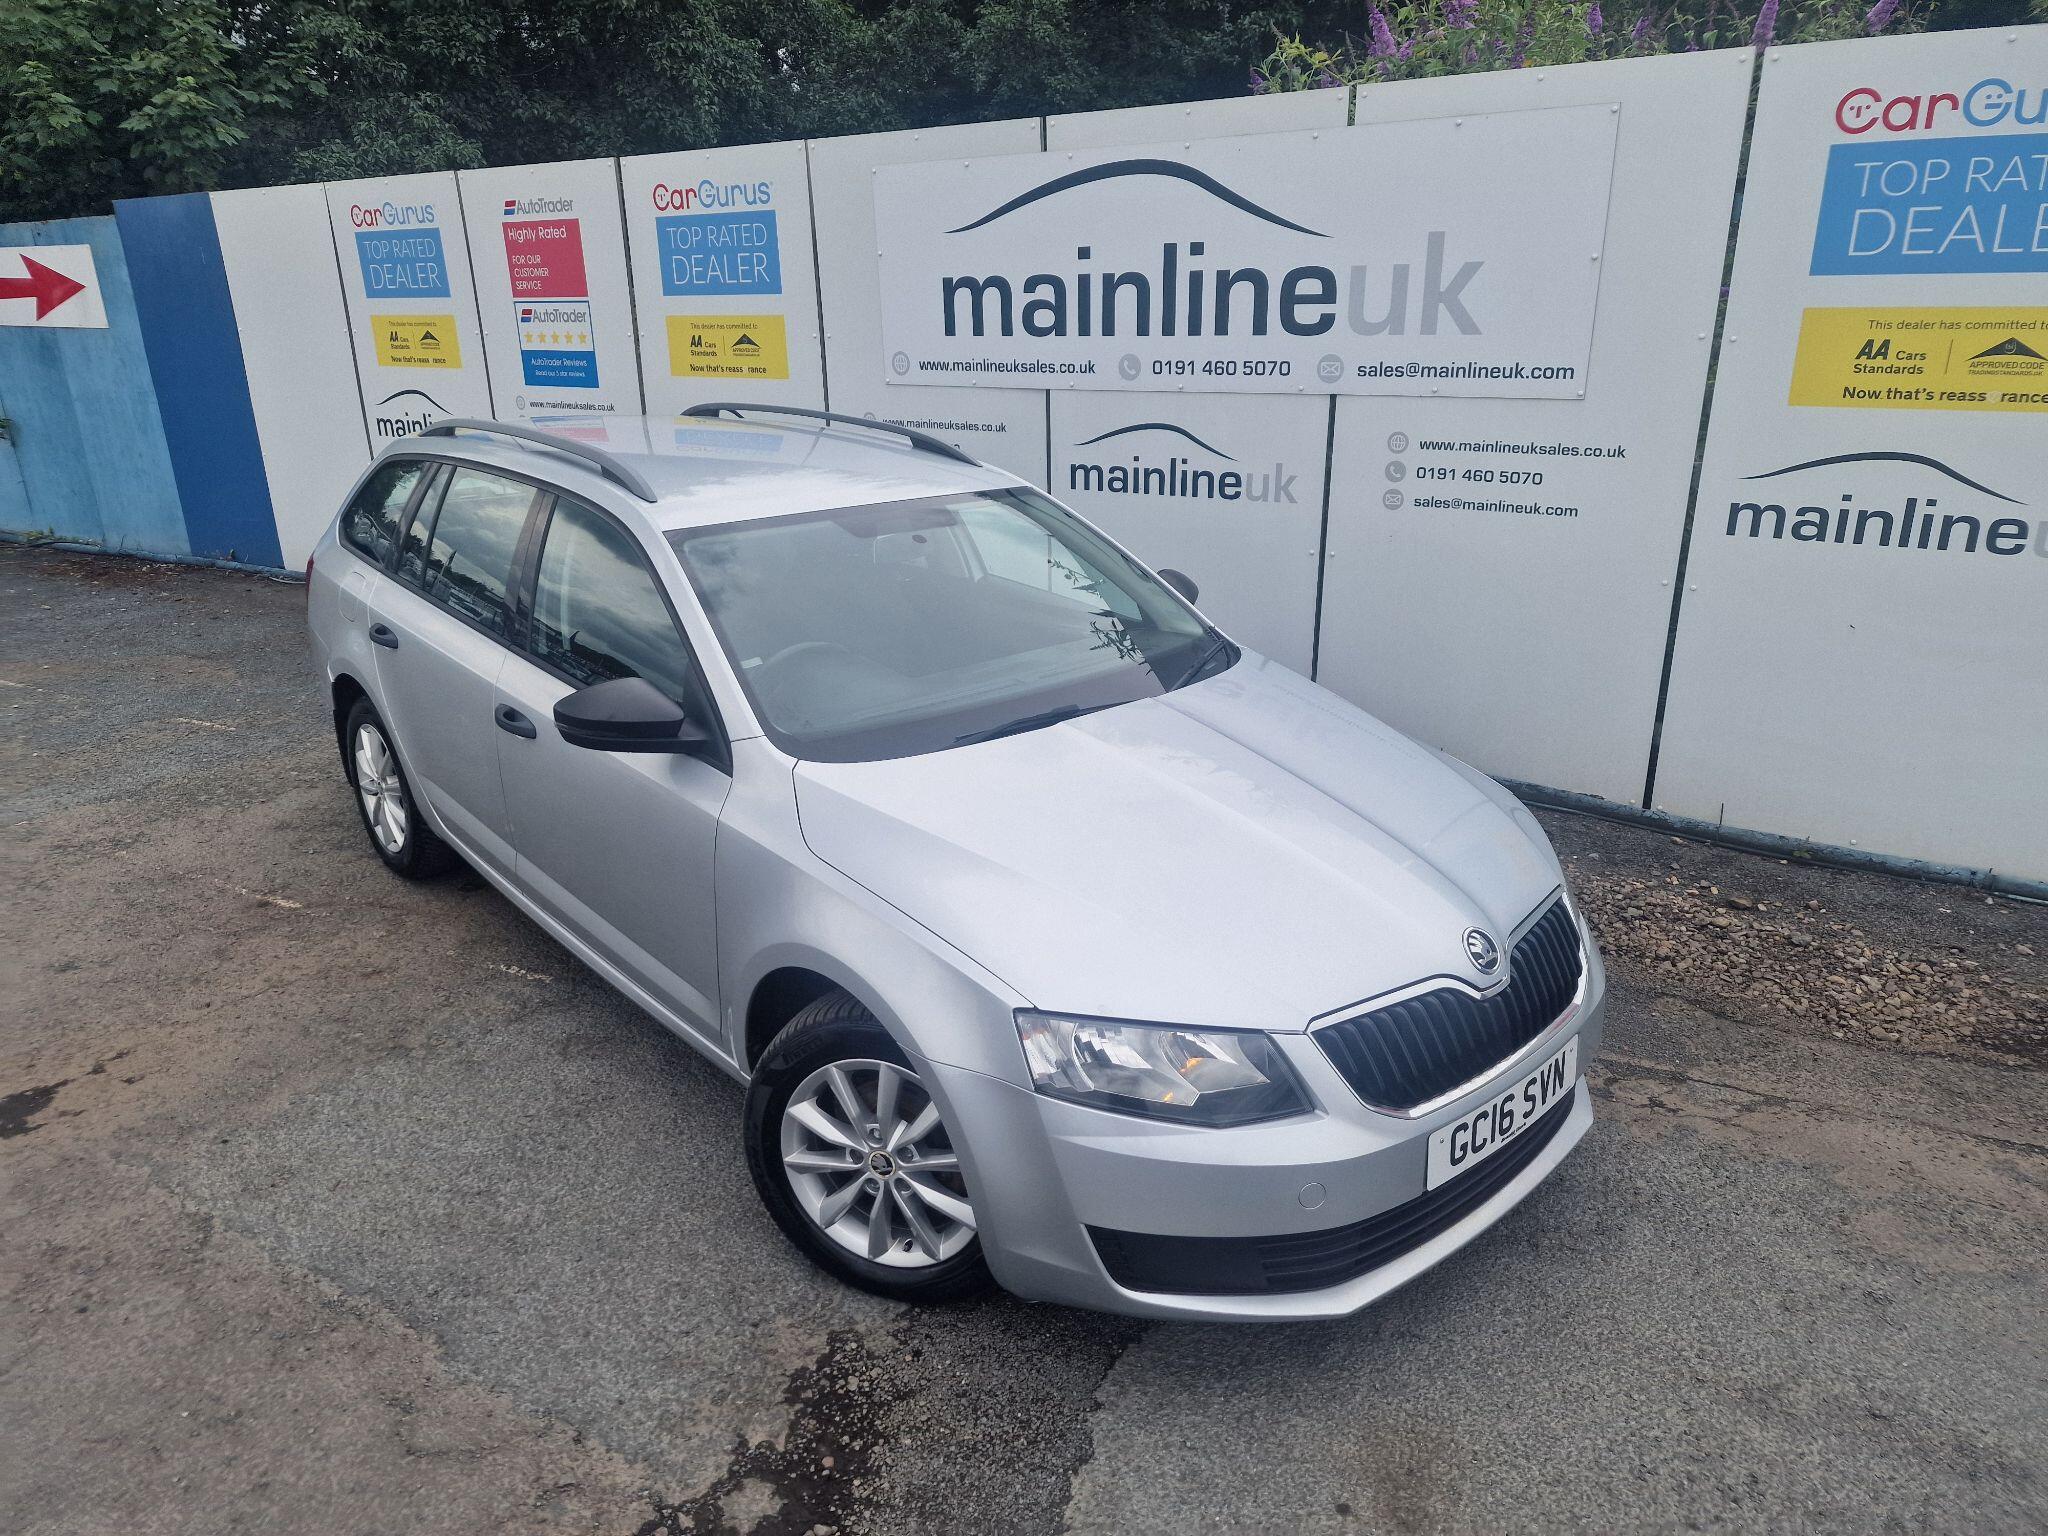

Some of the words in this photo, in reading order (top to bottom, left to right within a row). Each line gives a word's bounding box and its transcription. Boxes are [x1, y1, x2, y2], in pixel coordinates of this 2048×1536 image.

[1854, 158, 1950, 197] TOP
[1965, 154, 2048, 193] RAT
[652, 179, 771, 211] CarGurus
[351, 202, 435, 227] CarGurus
[517, 197, 574, 215] AutoTrader
[508, 227, 536, 243] Highly
[538, 225, 567, 239] Rated
[666, 226, 701, 249] TOP
[707, 223, 767, 247] RATED
[363, 240, 389, 259] TOP
[392, 239, 436, 258] RATED
[512, 255, 526, 264] FOR
[527, 255, 541, 264] OUR
[370, 263, 442, 288] DEALER
[515, 268, 549, 277] CUSTOMER
[672, 253, 770, 285] DEALER
[516, 280, 542, 290] SERVICE
[942, 230, 1486, 337] mainlineuk
[533, 309, 587, 323] AutoTrader
[1869, 319, 1893, 330] This
[1896, 319, 1936, 330] dealer
[1939, 320, 1961, 330] has
[1965, 319, 2037, 330] committed
[2041, 320, 2048, 330] t
[390, 331, 398, 342] AA
[690, 335, 702, 347] AA
[1855, 339, 1891, 360] AA
[1896, 350, 1927, 361] Cars
[563, 358, 588, 366] Reviews
[690, 364, 704, 372] Now
[705, 364, 724, 373] that's
[919, 358, 1096, 374] www.mainlineuksales.co.uk
[1152, 360, 1195, 375] 0191
[1202, 360, 1237, 376] 460
[1243, 360, 1291, 376] 5070
[1357, 361, 1575, 379] sales@mainlineuk.com
[1853, 363, 1924, 375] Standards
[1969, 361, 2018, 369] APPROVED
[2020, 361, 2045, 369] CODE
[1843, 386, 1881, 400] Now
[1886, 387, 1934, 401] that's
[530, 401, 615, 412] www.mainlineuksales.co.uk
[1419, 439, 1626, 459] www.mainlineuksales.co.uk
[1070, 455, 1298, 503] mainlineuk
[1416, 466, 1456, 481] 0191
[1462, 469, 1494, 482] 460
[1499, 471, 1543, 485] 5070
[1414, 496, 1579, 517] sales@mainlineuk.com
[1450, 1093, 1515, 1167] GC16
[1523, 1051, 1566, 1119] SVN
